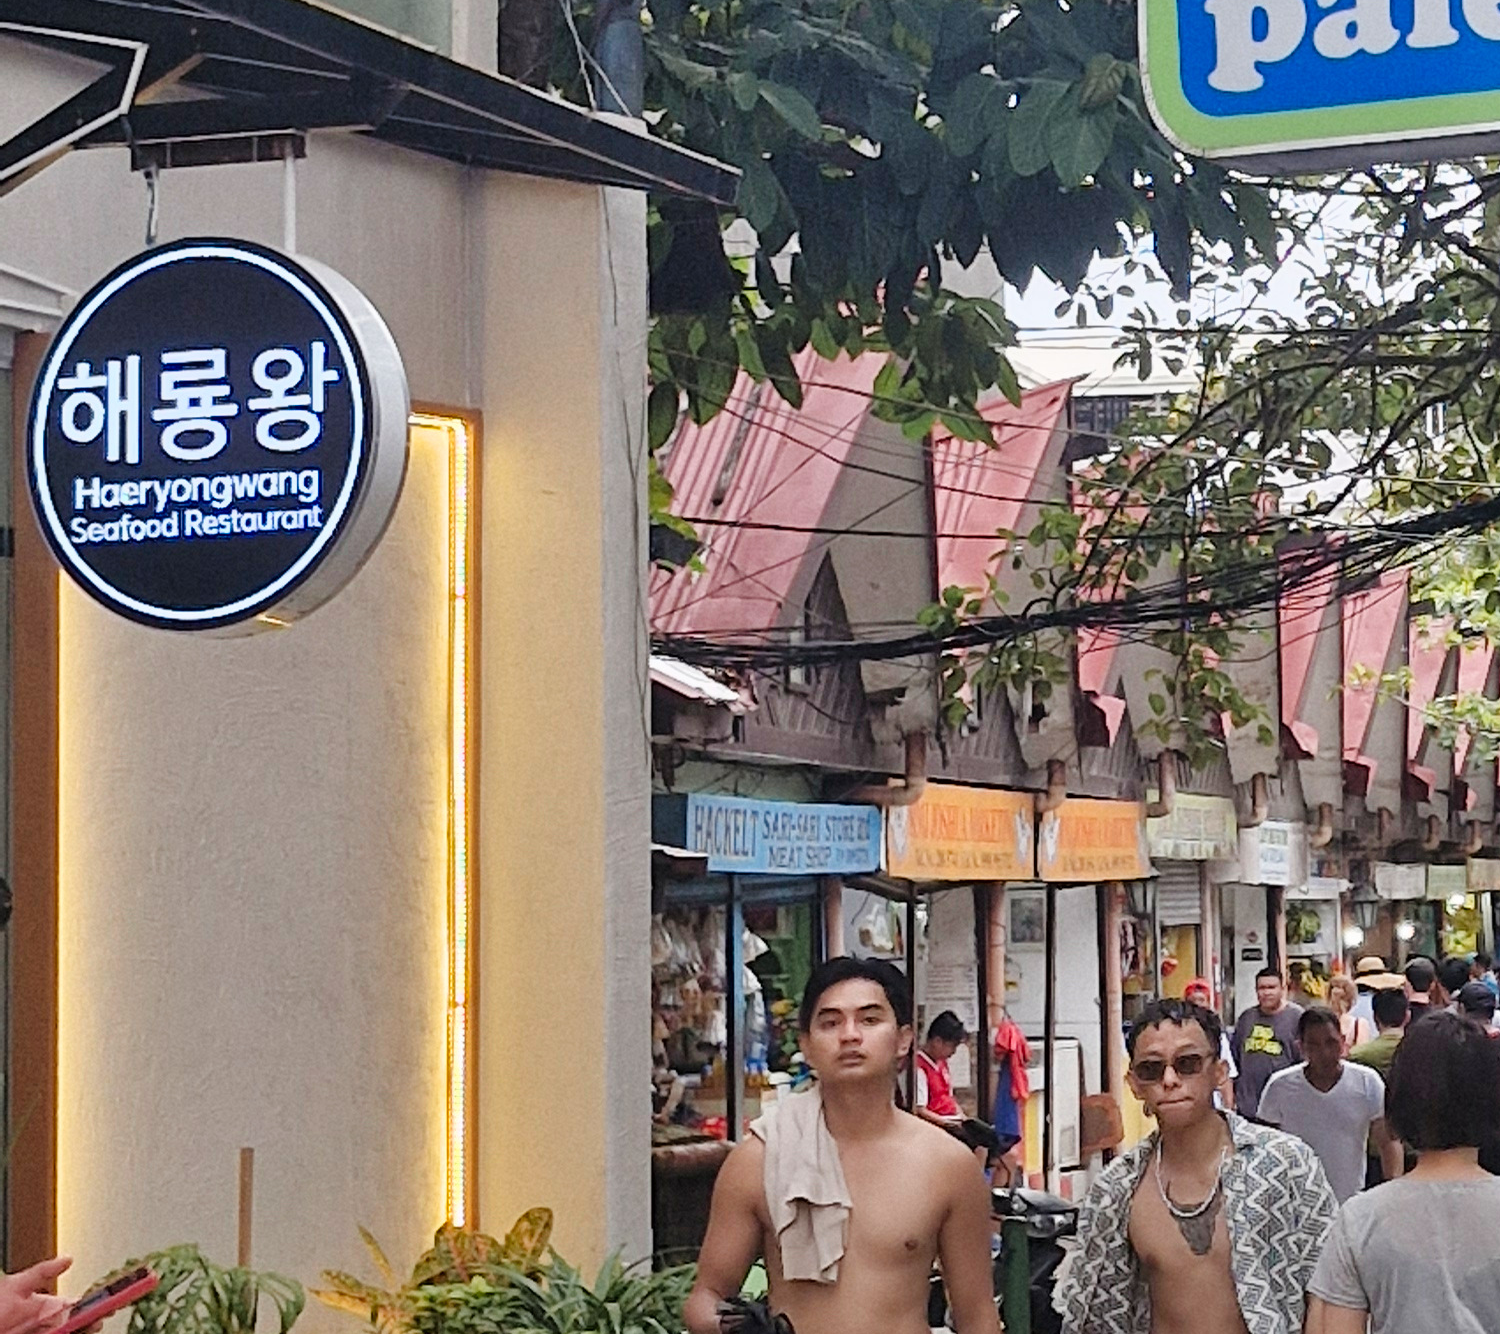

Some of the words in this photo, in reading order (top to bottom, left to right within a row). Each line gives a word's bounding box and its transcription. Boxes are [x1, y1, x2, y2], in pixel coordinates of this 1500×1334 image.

[57, 340, 340, 464] 해룡왕
[73, 469, 319, 512] Haeryongwang
[70, 511, 179, 544] Seafood
[185, 506, 323, 537] Restaurant
[762, 810, 821, 842] SARI-SARI
[825, 815, 855, 843] STORE
